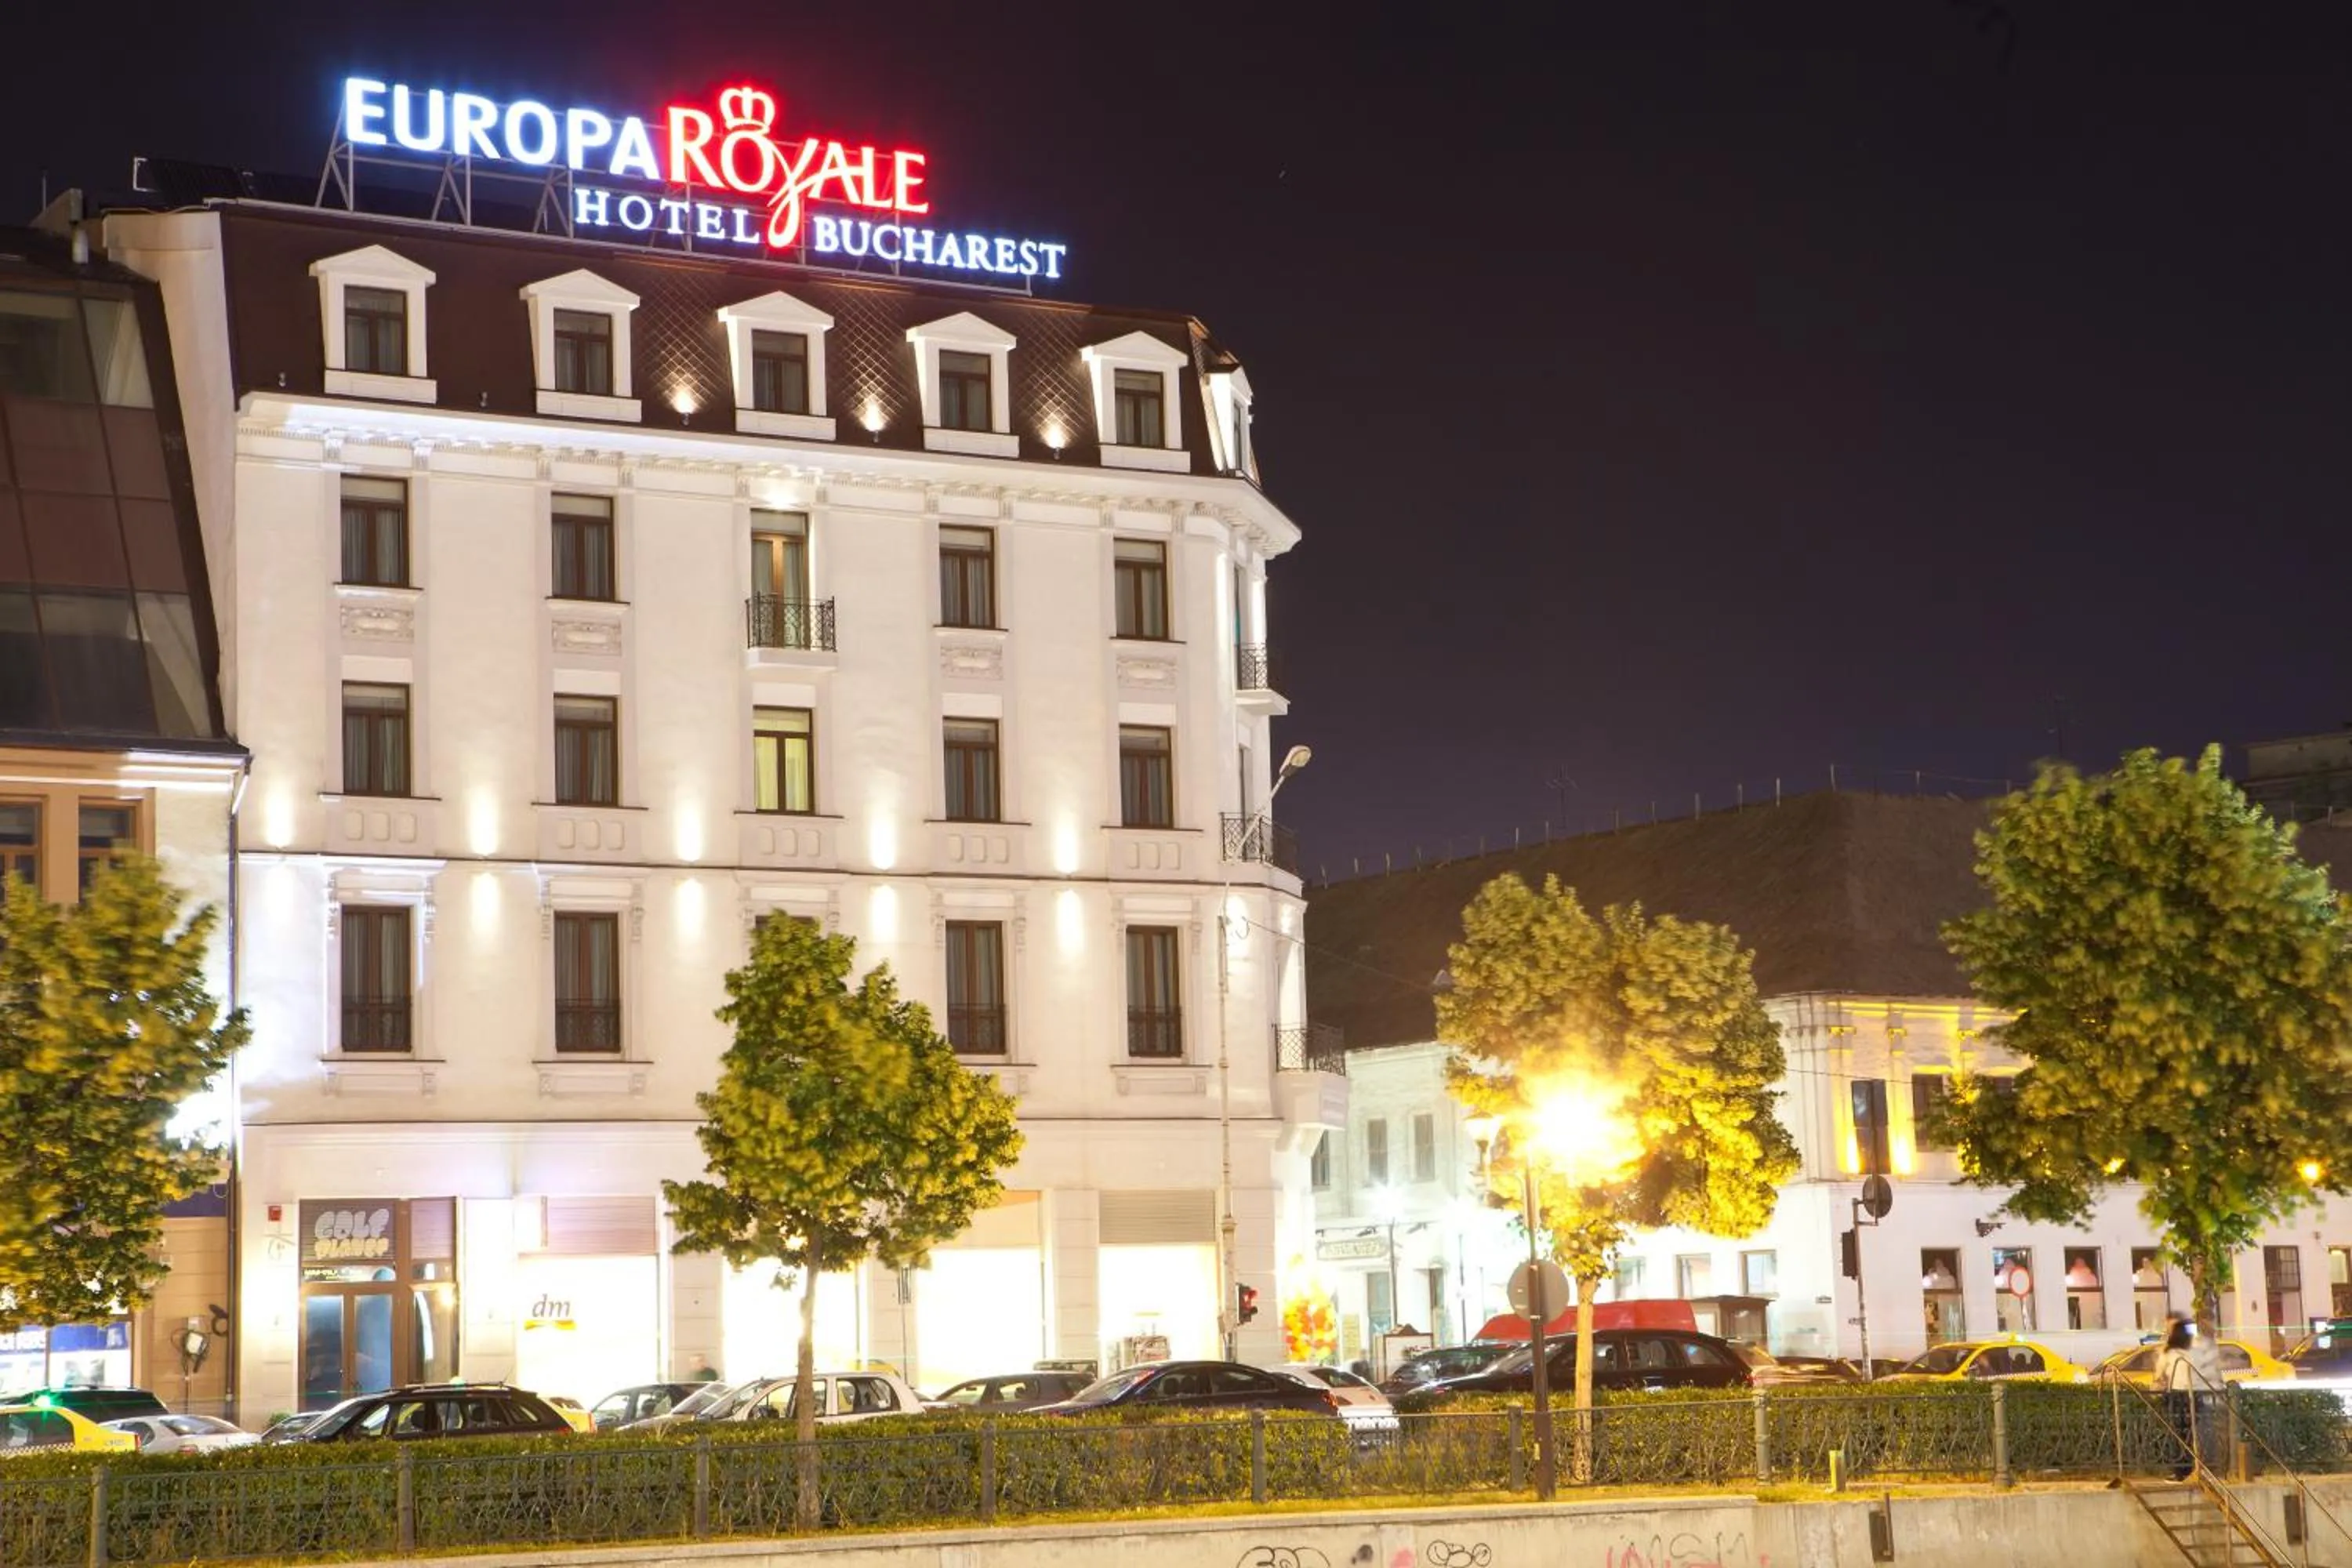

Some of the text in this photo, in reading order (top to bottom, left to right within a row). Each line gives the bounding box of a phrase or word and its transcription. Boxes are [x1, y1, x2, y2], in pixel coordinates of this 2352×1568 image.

[345, 77, 931, 249] EUROPA ROYALE
[574, 188, 1067, 279] HOTEL BUCHAREST
[532, 1293, 571, 1318] dm
